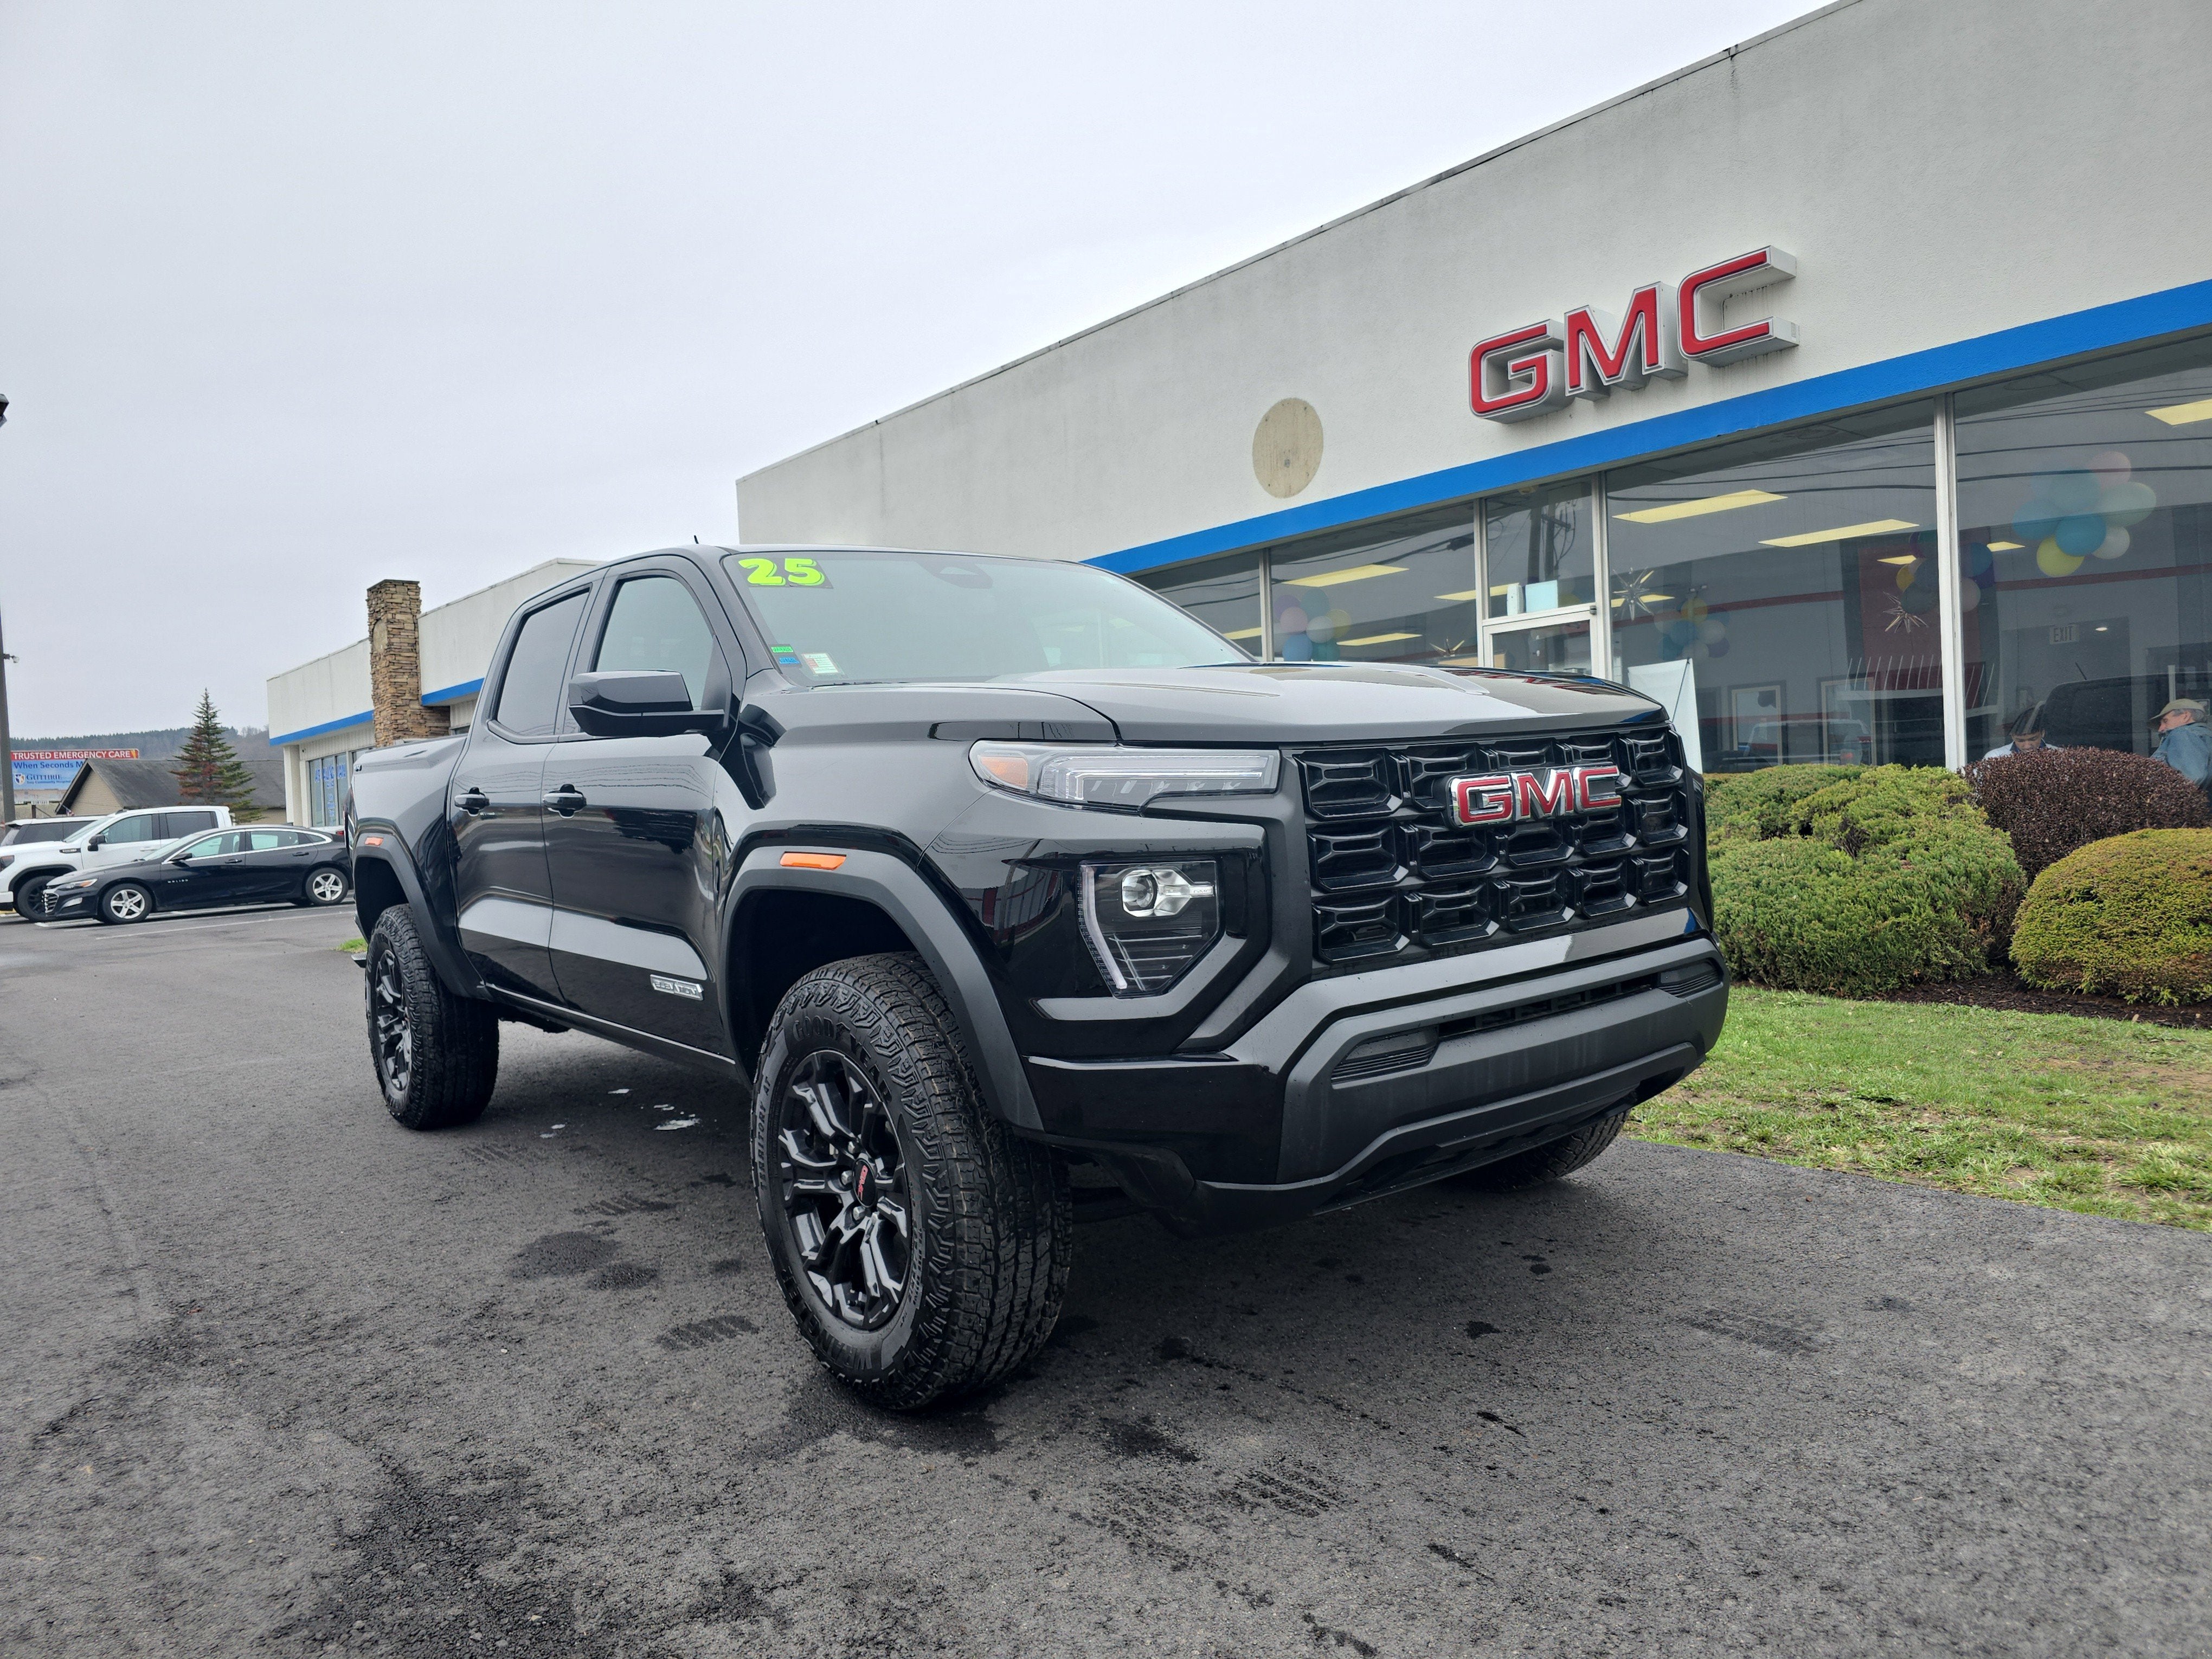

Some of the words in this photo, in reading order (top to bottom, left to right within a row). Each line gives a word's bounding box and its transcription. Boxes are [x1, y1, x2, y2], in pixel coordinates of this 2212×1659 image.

[1468, 245, 1776, 419] GMC
[738, 558, 825, 586] 25
[2053, 626, 2074, 642] EXIT
[40, 761, 74, 769] Seconds
[1453, 765, 1621, 825] GMC
[757, 1101, 767, 1191] TERRITORY
[763, 1076, 771, 1096] AT
